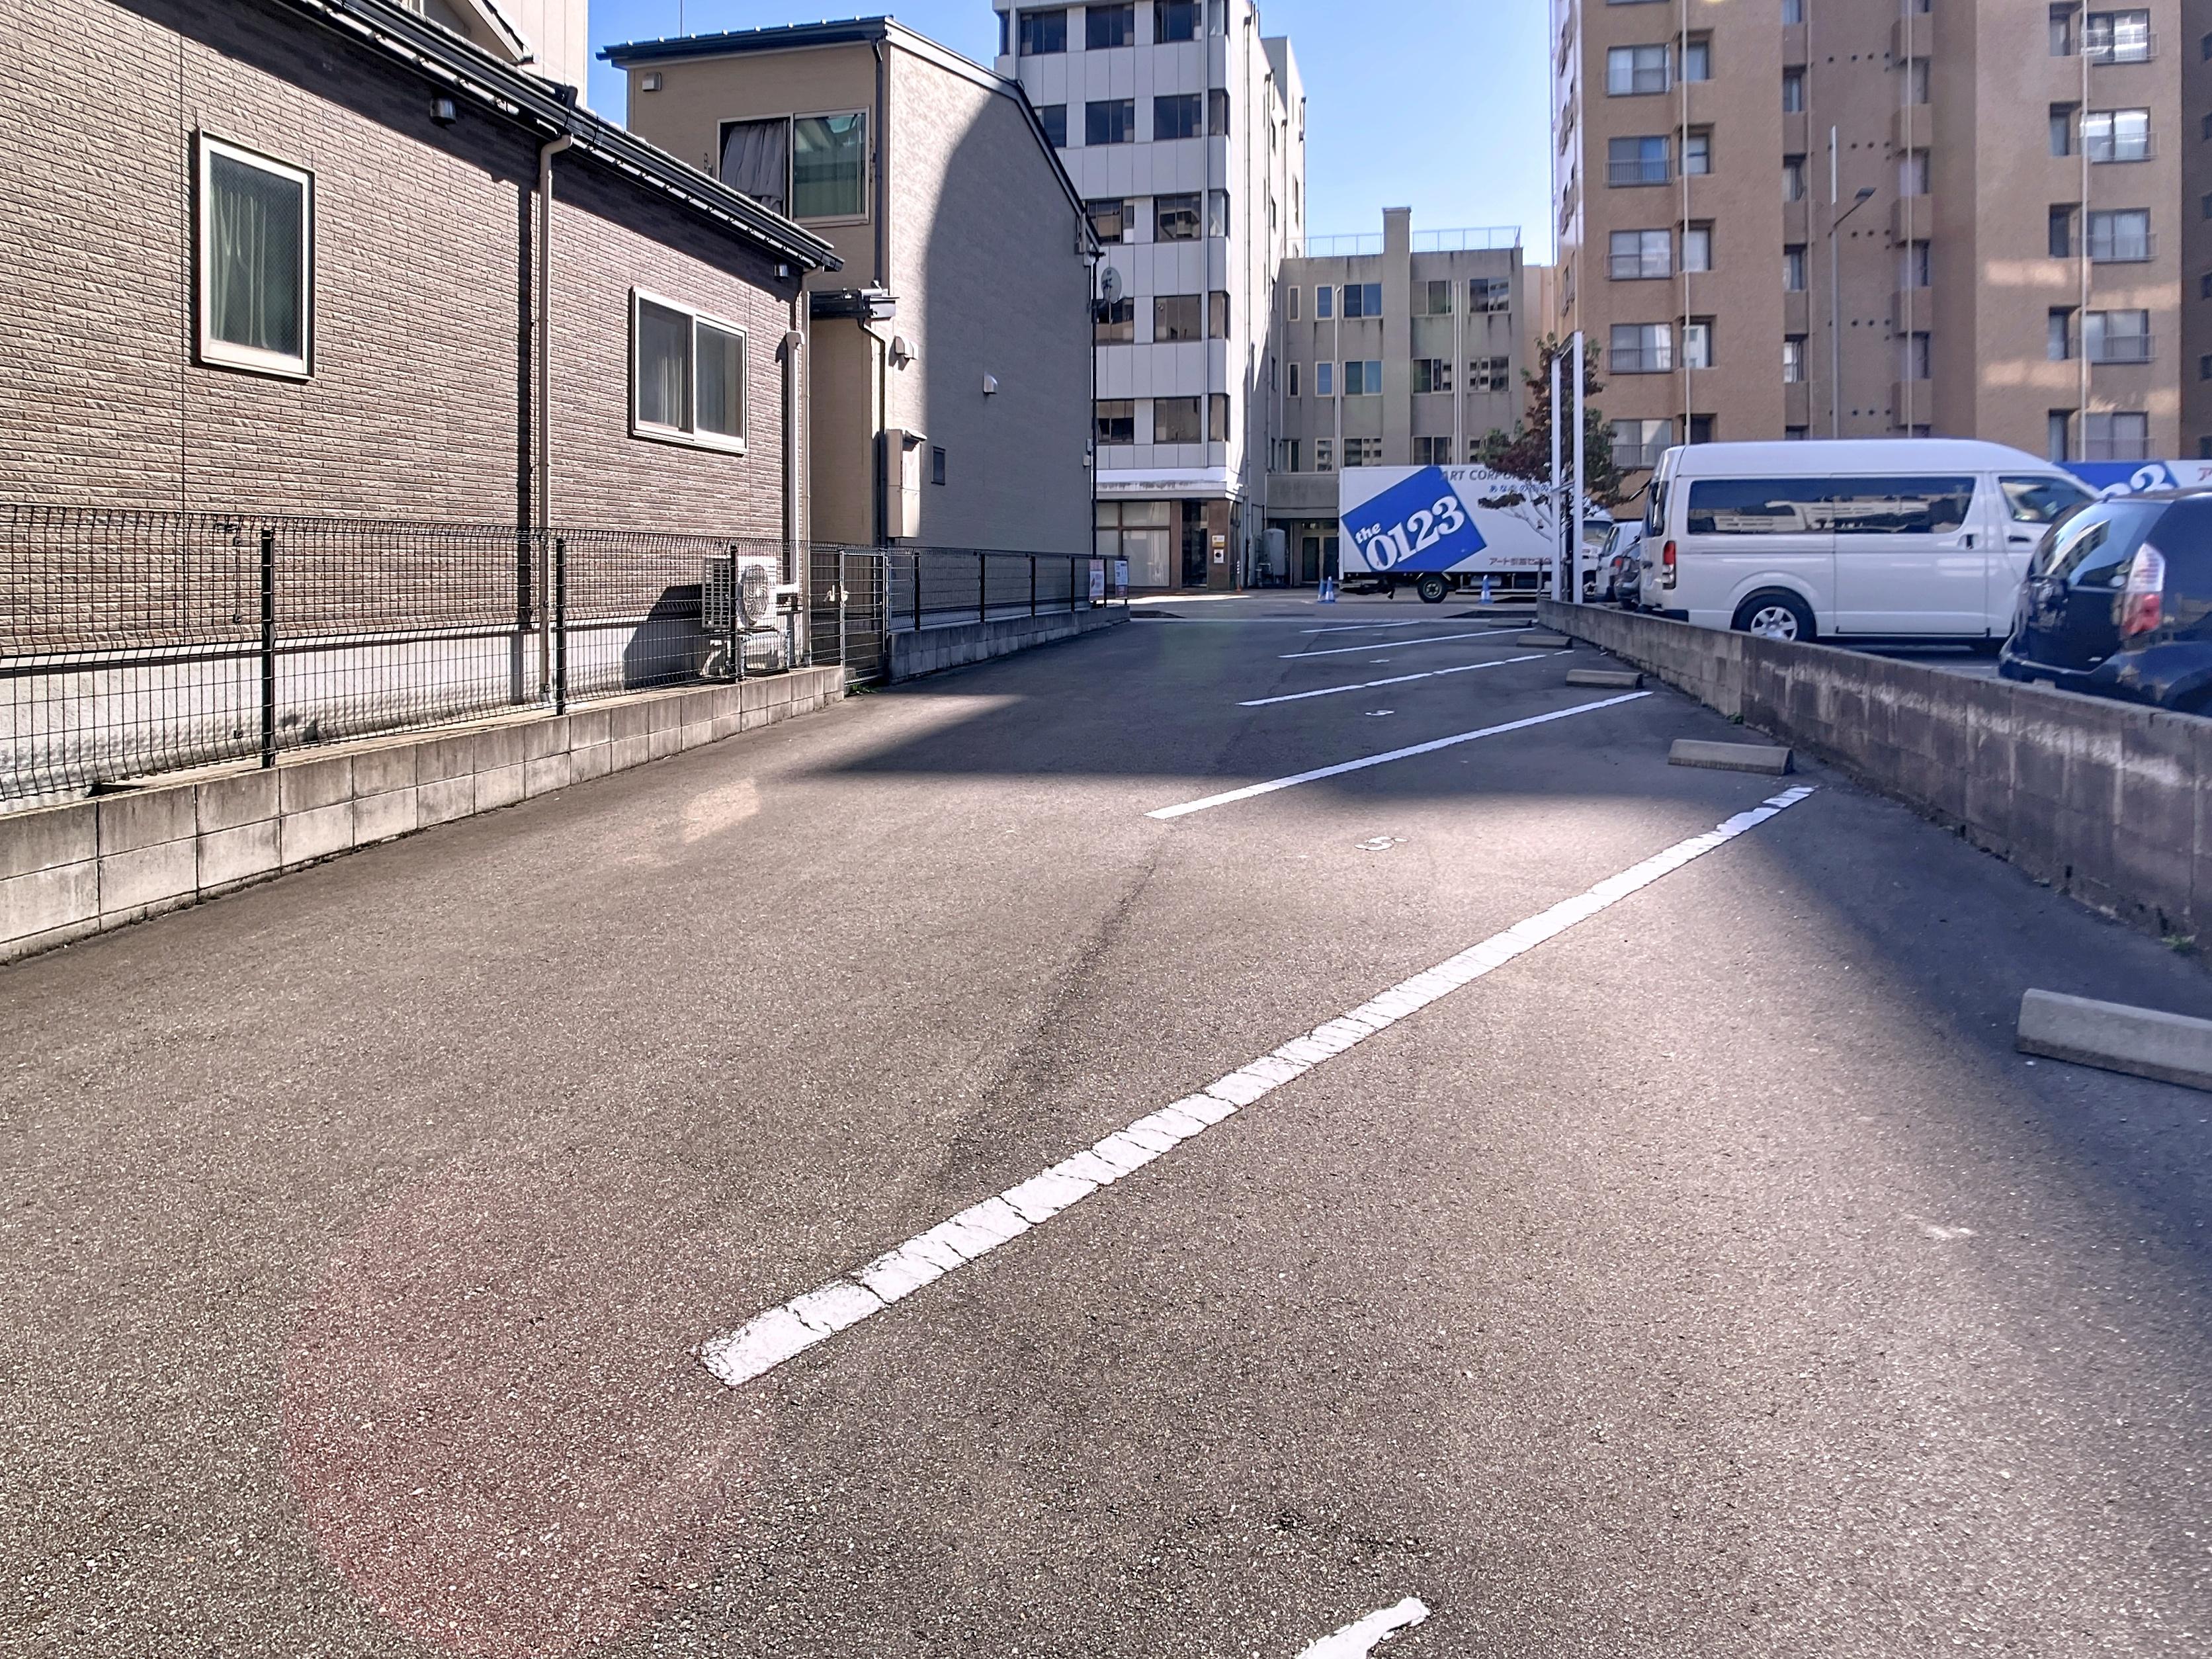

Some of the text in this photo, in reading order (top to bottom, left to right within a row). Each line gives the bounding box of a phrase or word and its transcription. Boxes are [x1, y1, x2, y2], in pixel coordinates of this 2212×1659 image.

[1440, 470, 1465, 481] ART
[1355, 523, 1381, 544] the
[1367, 496, 1465, 571] 0123
